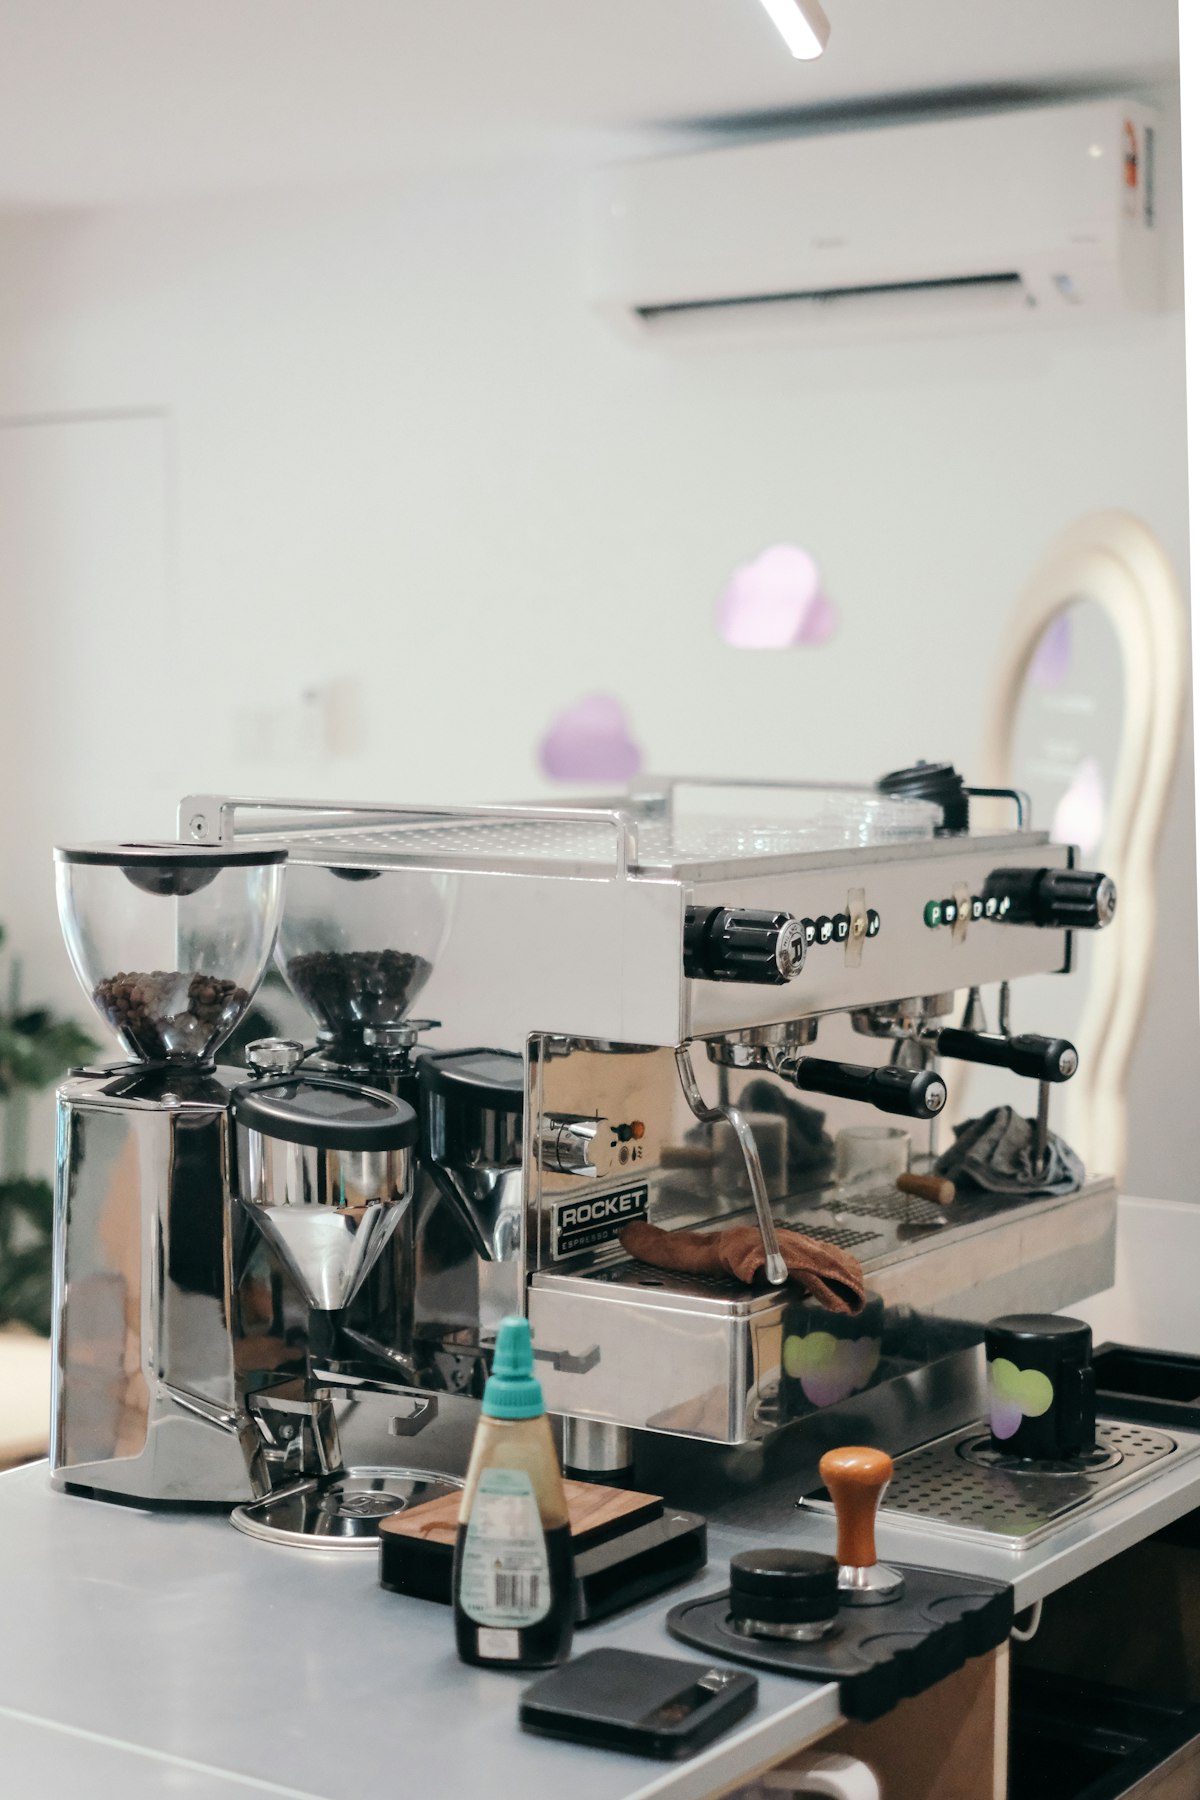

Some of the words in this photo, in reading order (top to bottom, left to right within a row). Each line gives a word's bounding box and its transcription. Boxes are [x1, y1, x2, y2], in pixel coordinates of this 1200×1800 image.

[932, 906, 940, 924] P
[563, 1190, 643, 1228] ROCKET
[561, 1230, 608, 1250] ESPRESSO
